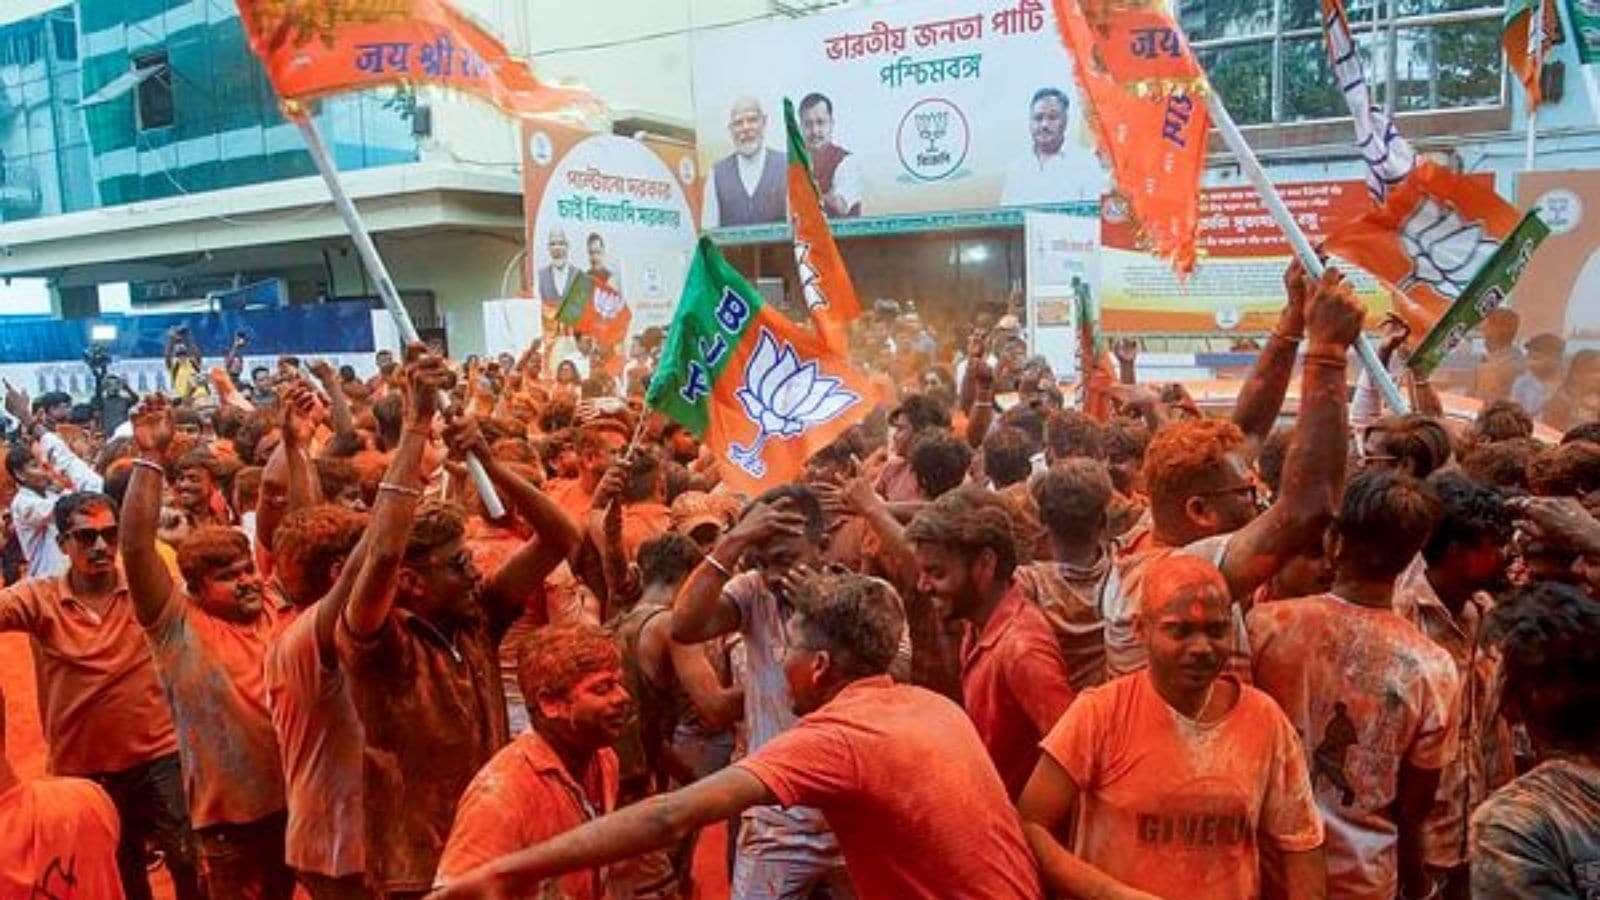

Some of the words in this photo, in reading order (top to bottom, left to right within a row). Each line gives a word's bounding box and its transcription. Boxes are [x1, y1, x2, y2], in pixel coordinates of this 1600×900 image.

[824, 21, 907, 60] ভারতীয়
[913, 13, 985, 48] জনতা
[354, 42, 412, 73] जय
[880, 53, 982, 88] পশ্চিমবঙ্গ
